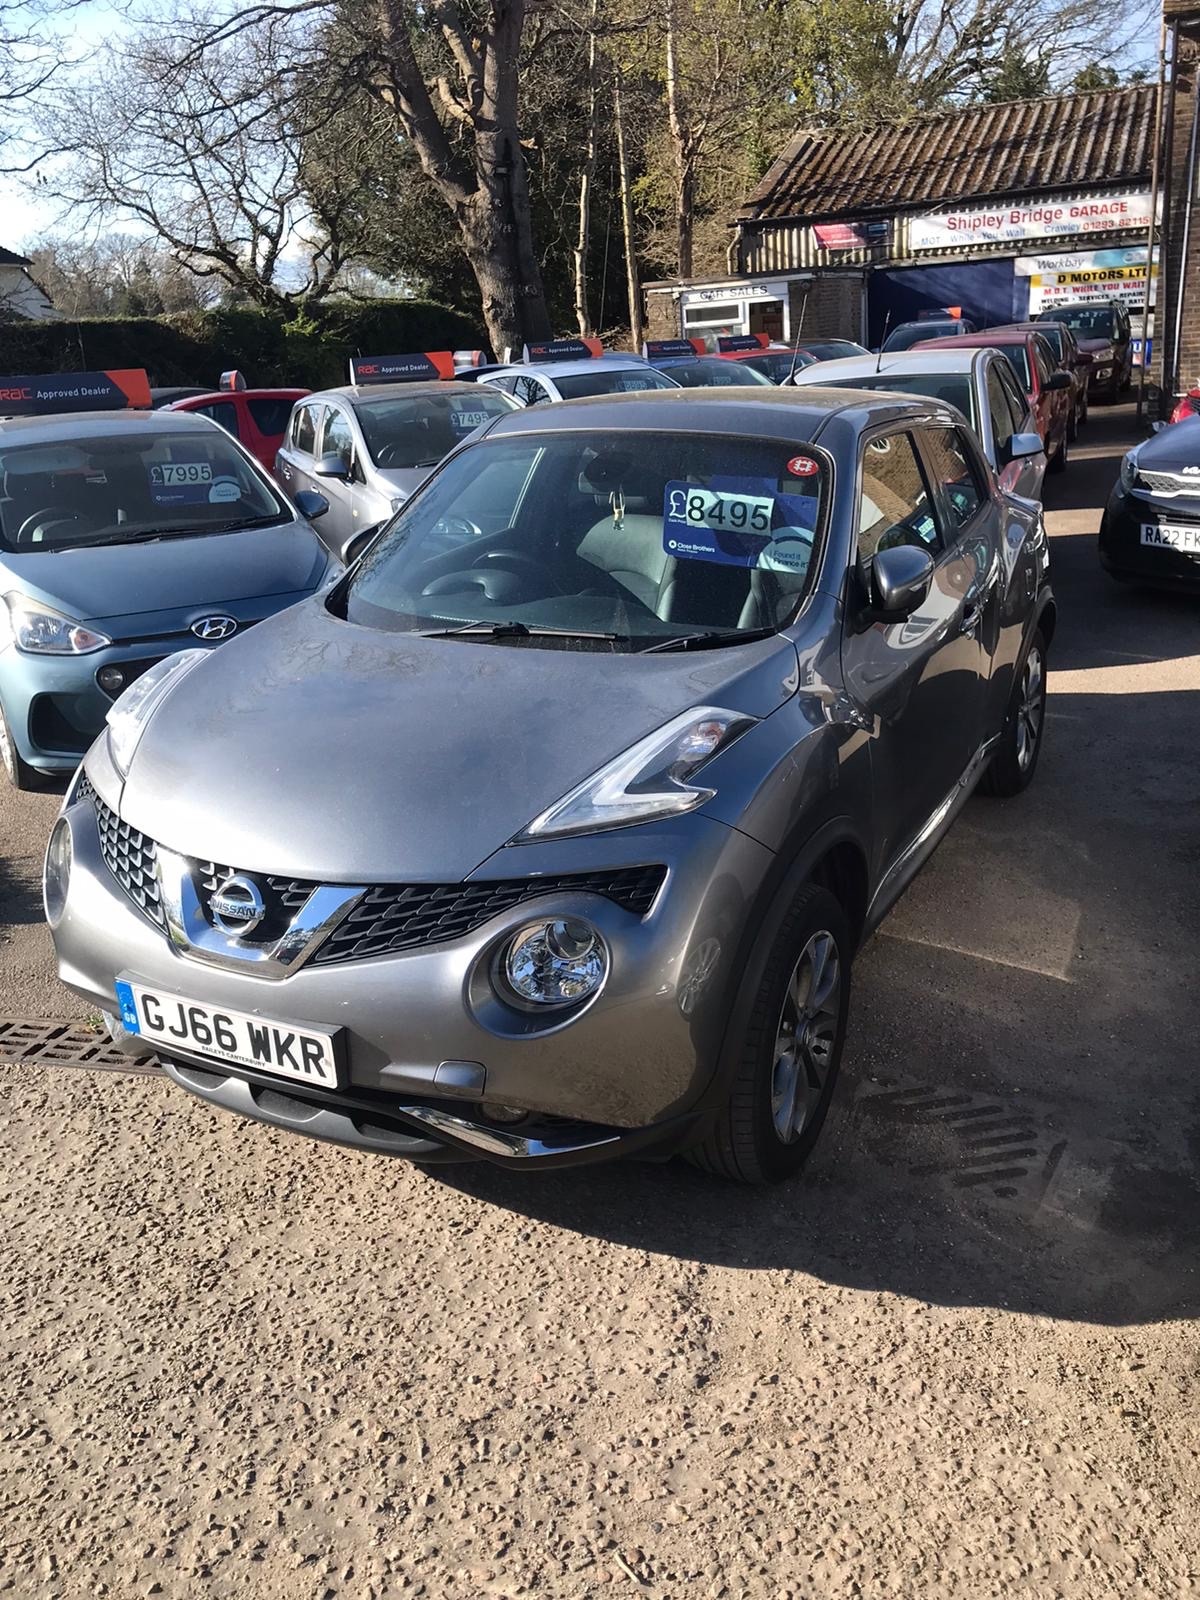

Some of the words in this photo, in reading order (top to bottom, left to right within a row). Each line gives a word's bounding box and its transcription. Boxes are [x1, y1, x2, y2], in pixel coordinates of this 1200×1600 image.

[947, 213, 1004, 231] Shipley
[1010, 208, 1063, 224] Bridge
[1070, 201, 1128, 217] GARAGE
[1044, 222, 1081, 235] Crawley
[1083, 219, 1114, 231] 01293
[1119, 216, 1152, 227] 82115
[921, 236, 940, 246] MOT
[981, 230, 997, 240] You
[1006, 228, 1026, 238] Wait
[1037, 257, 1085, 269] Workbay
[1057, 274, 1066, 284] D
[1071, 269, 1124, 283] MOTORS
[729, 285, 768, 297] SALES
[1072, 285, 1099, 294] WHILE
[1102, 283, 1120, 291] YOU
[1123, 281, 1146, 289] WAIT
[381, 365, 408, 374] Approved
[410, 364, 429, 372] Dealer
[36, 387, 79, 400] Approved
[81, 386, 111, 396] Dealer
[151, 465, 211, 482] £7995
[668, 489, 769, 531] £8495
[1145, 526, 1180, 546] RA22
[693, 544, 715, 553] Brothers
[773, 550, 795, 560] Found
[773, 557, 800, 568] Finance
[213, 900, 257, 917] NISSAN
[123, 1012, 137, 1024] GB
[141, 993, 238, 1053] GJ66
[246, 1021, 328, 1078] WKR
[202, 1045, 226, 1056] BAILEYS
[225, 1052, 266, 1068] CANTERBURY
